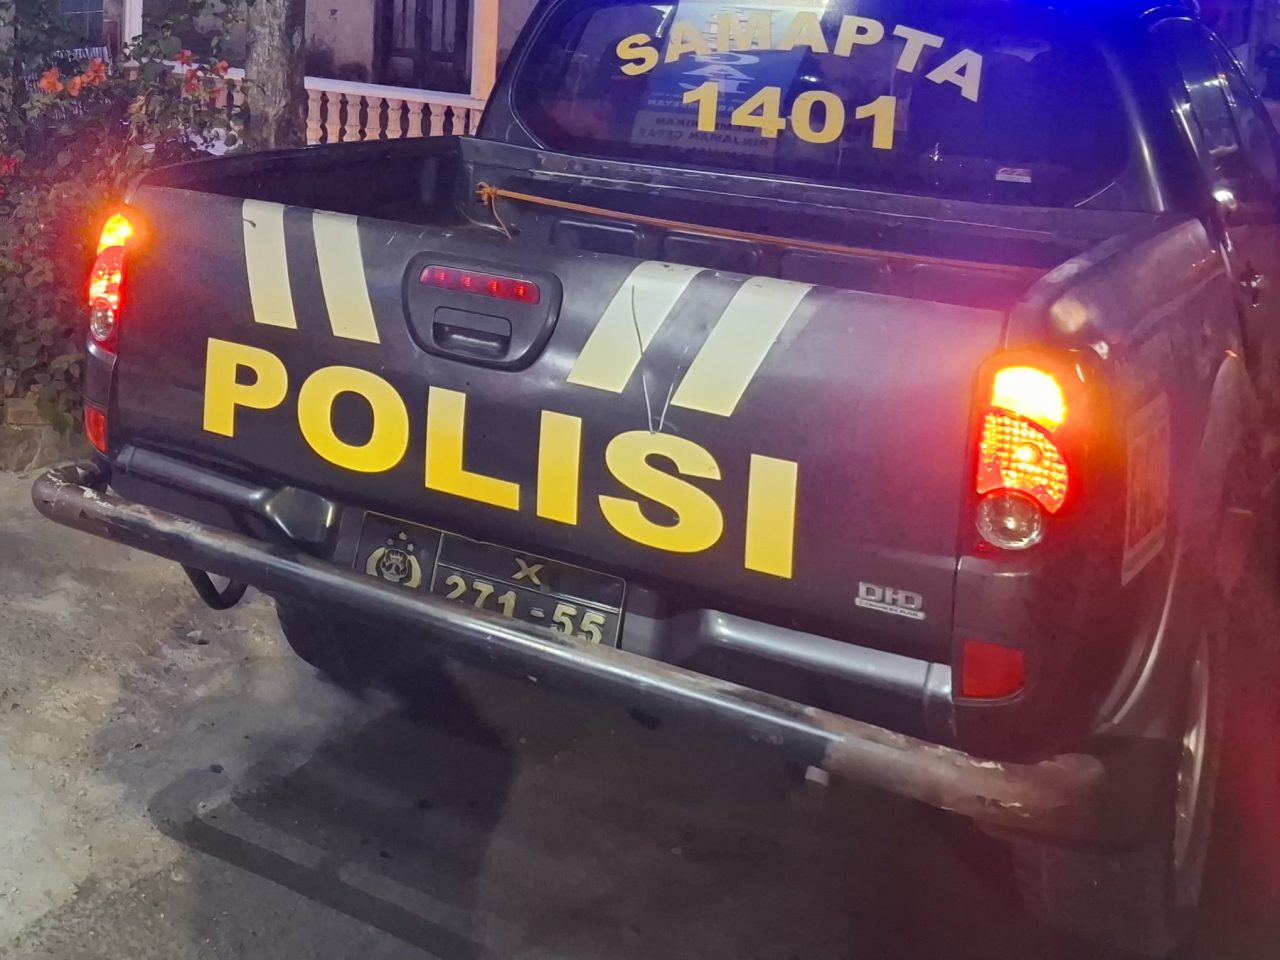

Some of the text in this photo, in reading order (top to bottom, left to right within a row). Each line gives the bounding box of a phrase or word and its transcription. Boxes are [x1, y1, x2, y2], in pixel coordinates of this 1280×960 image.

[616, 11, 983, 103] SAMAPTA
[682, 81, 897, 150] 1401
[202, 337, 798, 579] POLISI
[511, 558, 544, 585] X
